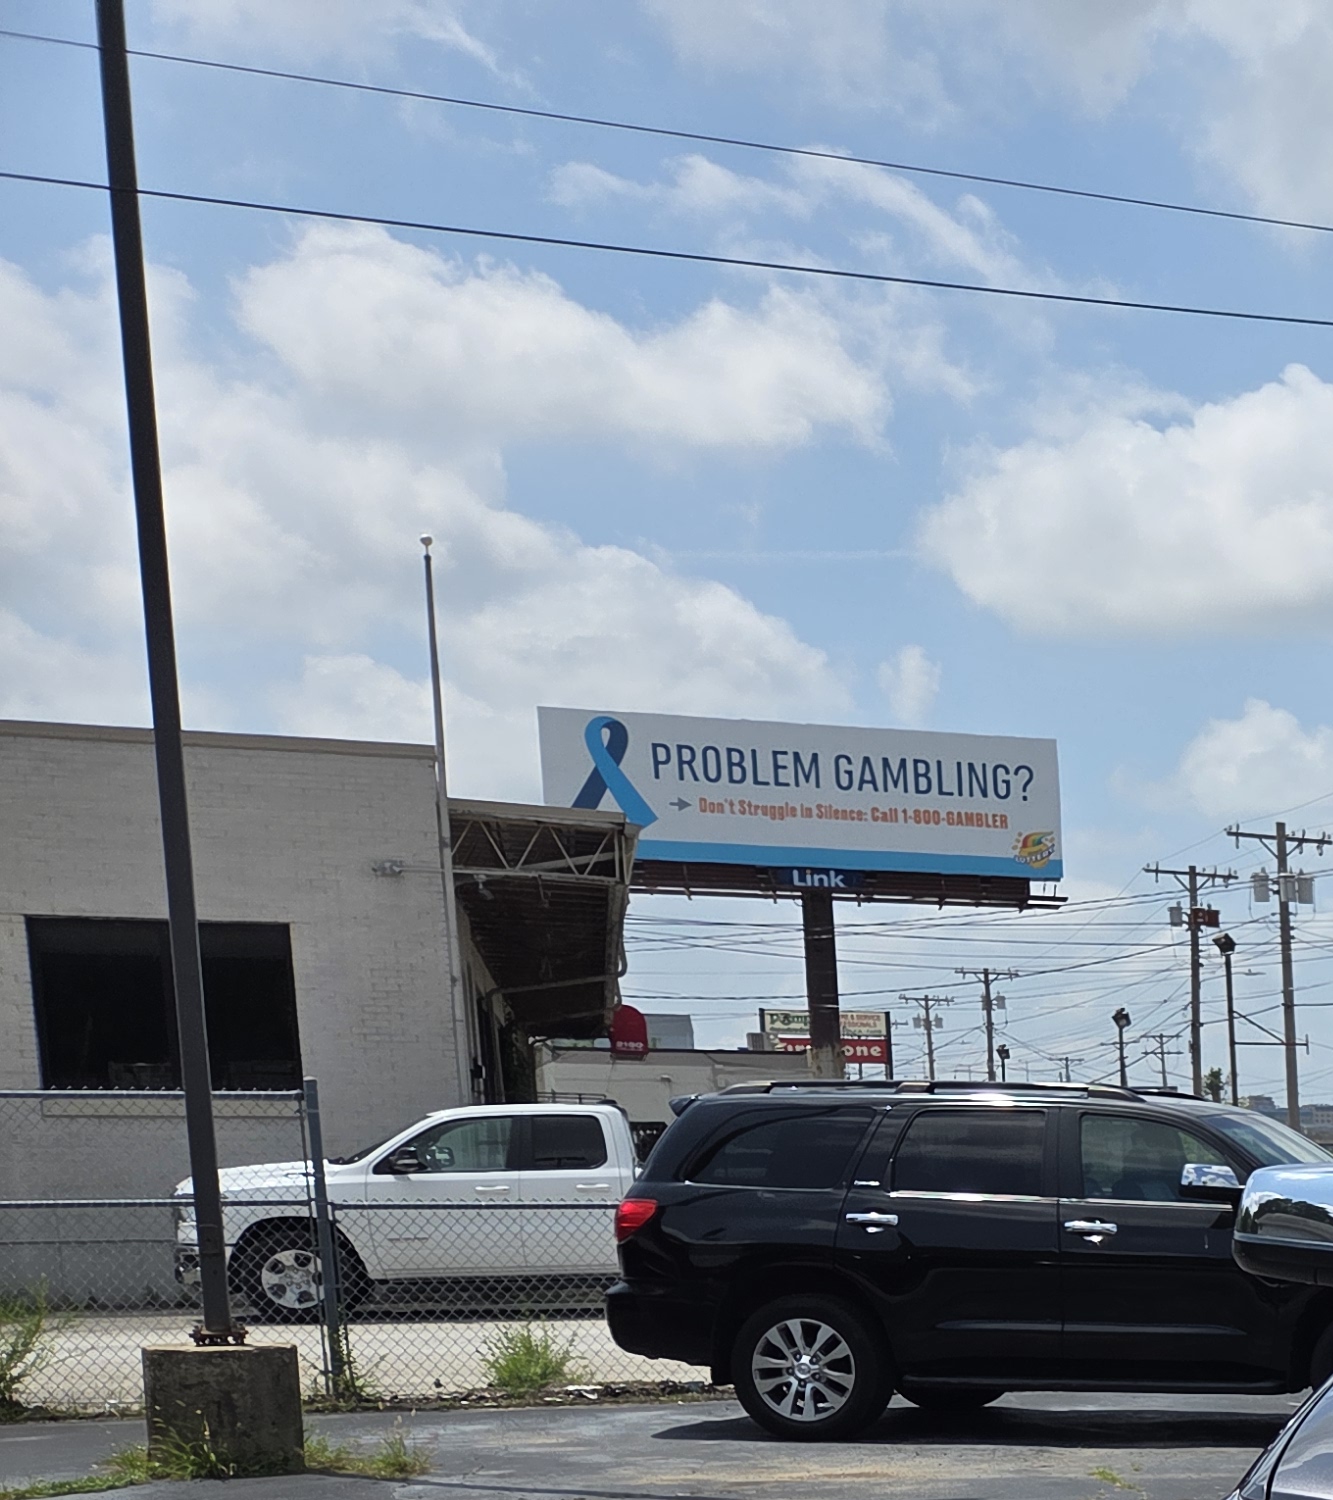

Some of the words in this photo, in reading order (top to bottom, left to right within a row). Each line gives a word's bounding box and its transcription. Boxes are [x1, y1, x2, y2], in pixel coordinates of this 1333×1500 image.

[651, 742, 821, 789] PROBLEM
[833, 754, 1034, 802] GAMBLING?
[699, 796, 735, 815] Don't
[738, 799, 798, 821] Struggle
[815, 803, 868, 822] Silence:
[870, 806, 899, 823] Call
[901, 807, 1009, 830] 1-800-GAMBLER
[1014, 843, 1056, 864] LOTTERY
[792, 869, 847, 888] Link
